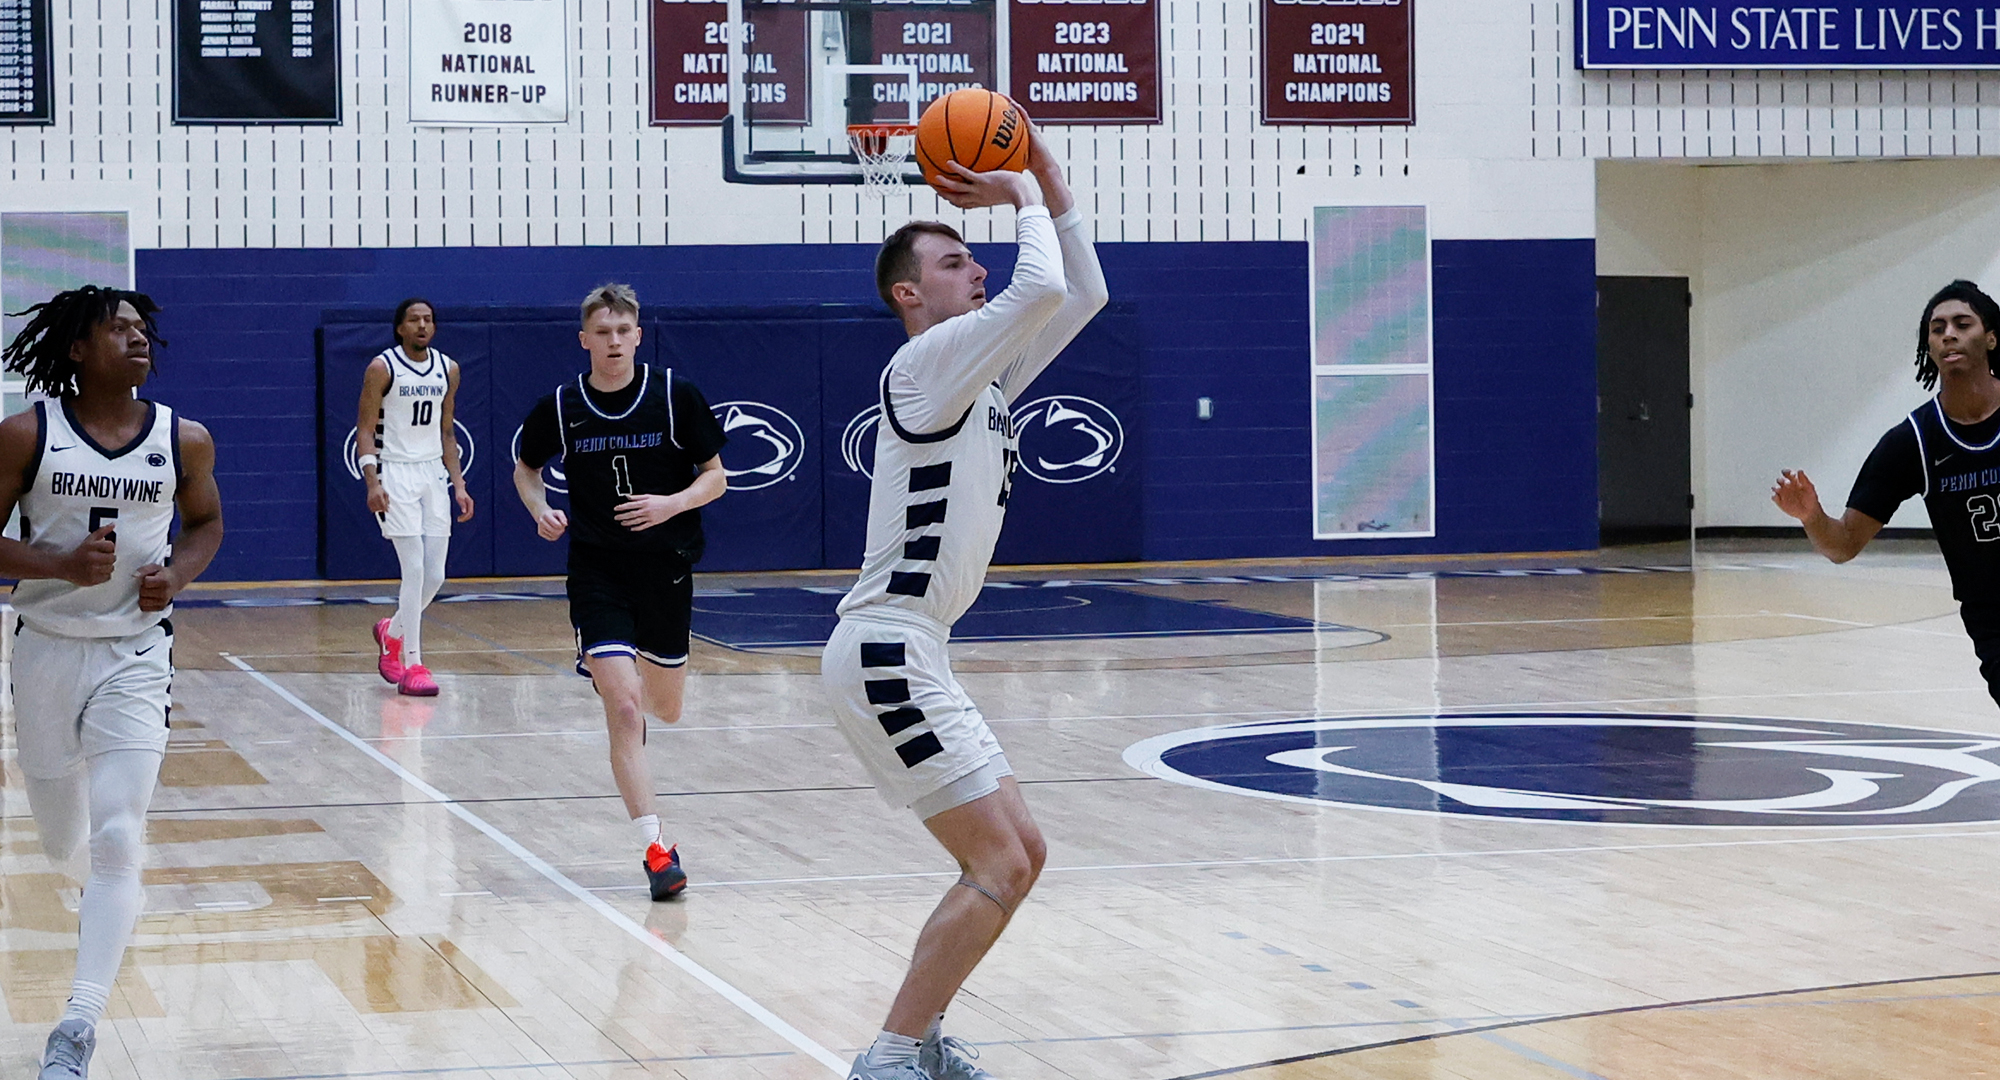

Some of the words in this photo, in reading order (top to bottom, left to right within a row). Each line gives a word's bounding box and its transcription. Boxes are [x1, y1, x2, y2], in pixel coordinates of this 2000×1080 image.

[464, 22, 512, 44] 2018
[704, 21, 756, 44] 208
[902, 22, 952, 45] 2021
[1054, 22, 1111, 45] 2023
[1310, 22, 1365, 45] 2024
[1607, 7, 1717, 49] PENN
[1730, 7, 1840, 50] STATE
[1855, 7, 1962, 50] LIVES
[441, 54, 535, 74] NATIONAL
[1037, 53, 1129, 74] NATIONAL
[1293, 53, 1382, 74] NATIONAL
[431, 84, 547, 103] RUNNER-UP
[1029, 82, 1138, 102] CHAMPIONS
[1285, 82, 1391, 103] CHAMPIONS
[411, 400, 433, 426] 10
[575, 437, 607, 453] PENN
[609, 432, 663, 449] COLLEGE
[51, 471, 163, 503] BRANDYWINE
[612, 455, 633, 497] 1
[1940, 472, 1978, 492] PENN
[1966, 494, 2000, 542] 2
